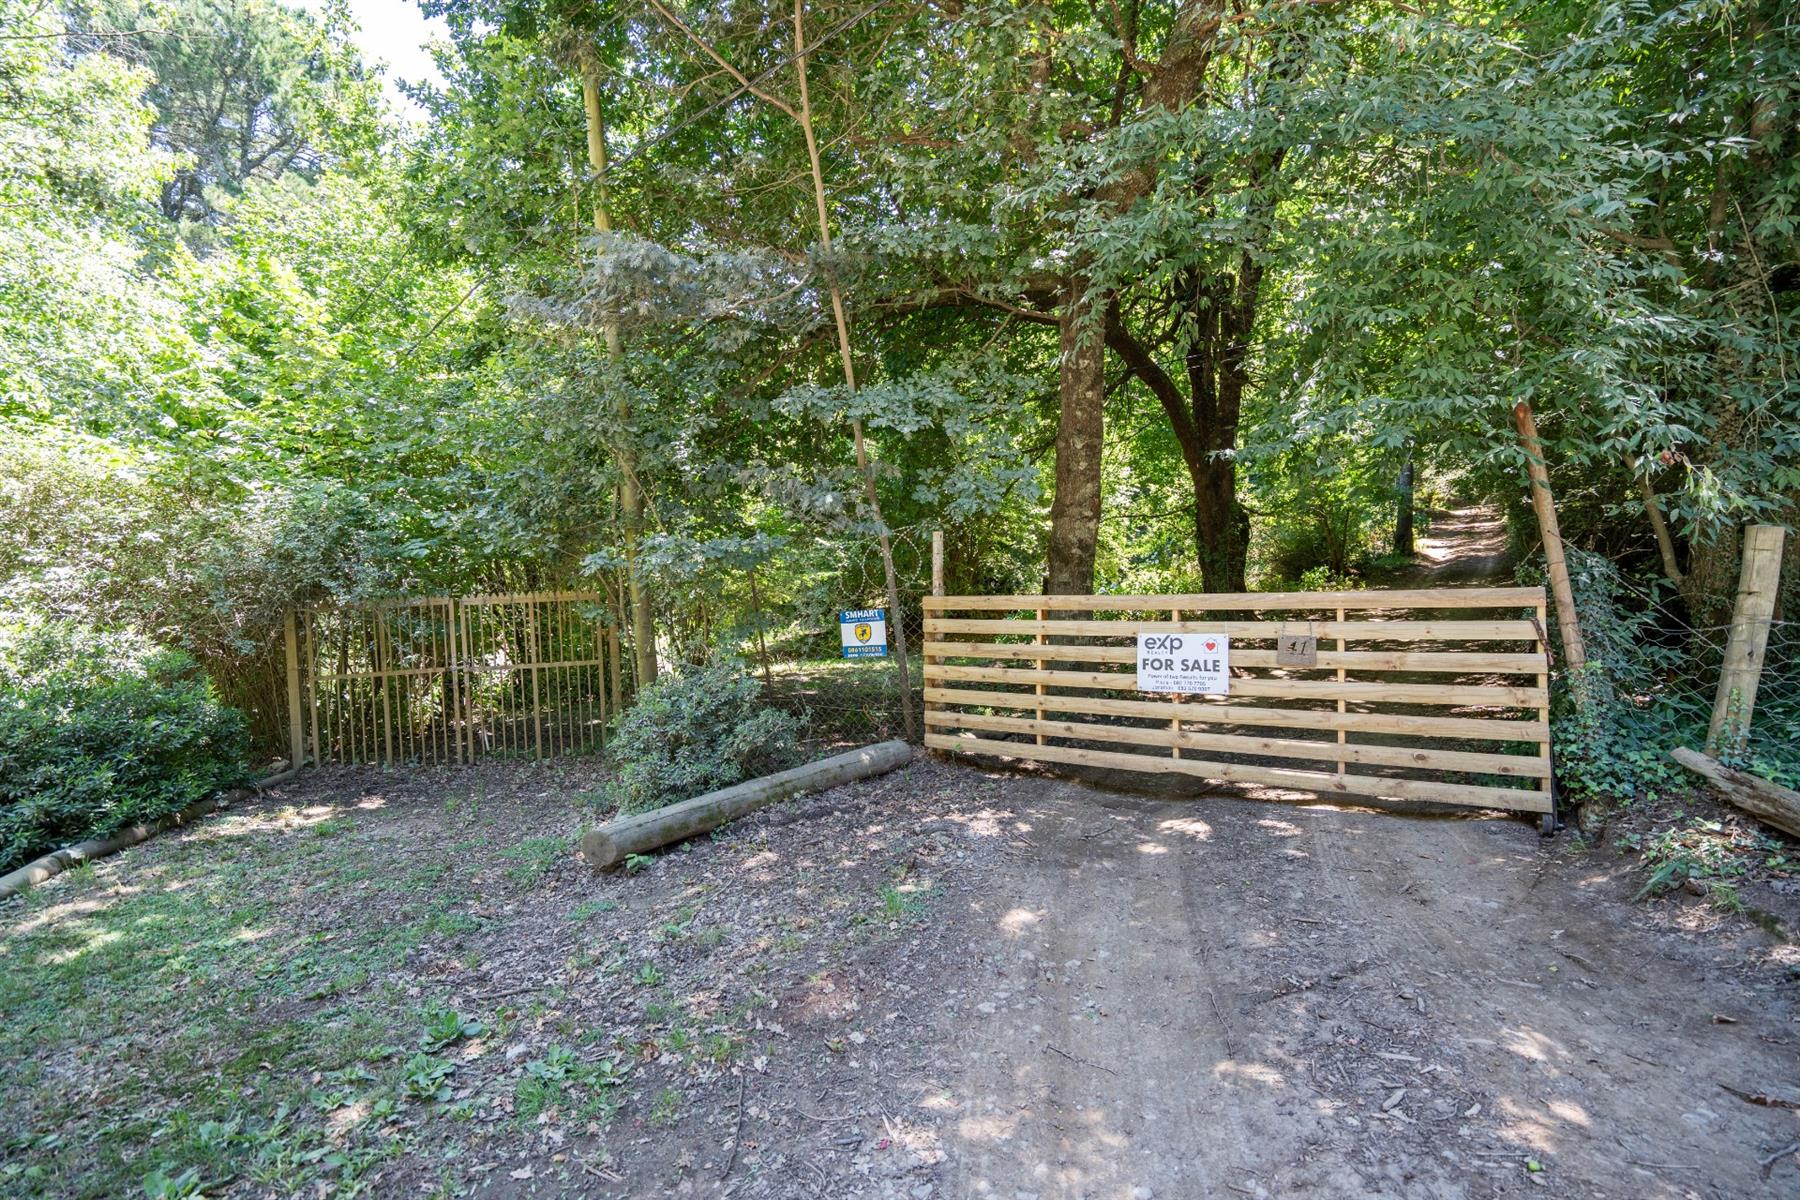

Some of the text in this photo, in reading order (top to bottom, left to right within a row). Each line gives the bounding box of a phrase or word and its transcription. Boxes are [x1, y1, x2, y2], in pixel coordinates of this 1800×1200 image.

[845, 609, 879, 619] SMHART
[1142, 658, 1220, 672] FOR SALE
